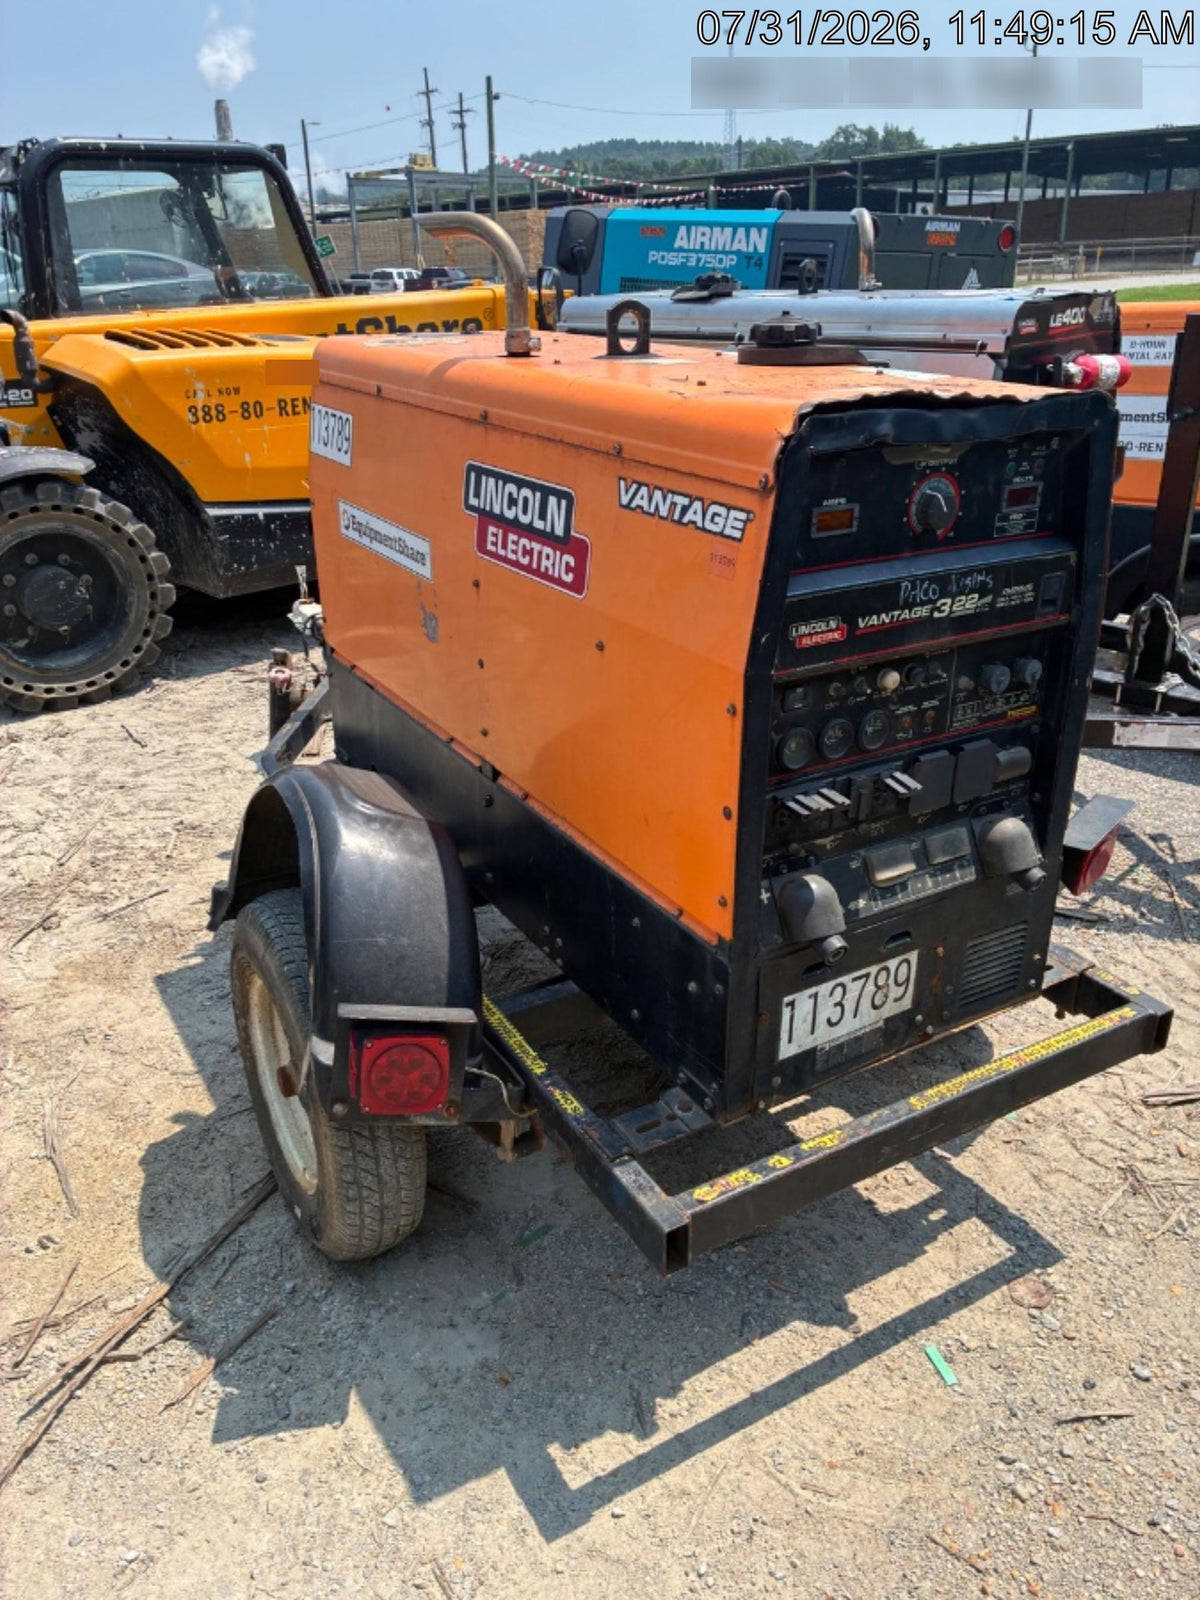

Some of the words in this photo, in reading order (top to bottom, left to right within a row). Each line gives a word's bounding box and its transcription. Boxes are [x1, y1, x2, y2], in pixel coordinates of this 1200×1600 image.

[674, 225, 768, 253] AIRMAN
[925, 220, 960, 232] AIRMAN
[744, 256, 763, 270] T4
[1050, 306, 1087, 327] LE400
[1123, 351, 1151, 361] ENTAL
[1154, 351, 1174, 361] RAT
[217, 386, 241, 398] NOW
[312, 405, 351, 456] 113789
[1119, 411, 1168, 424] mentS
[468, 470, 567, 537] LINCOLN
[618, 477, 748, 541] VANTAGE
[351, 513, 427, 567] EquipmentShare
[486, 525, 576, 584] ELECTRIC
[858, 606, 931, 628] VANTAGE
[933, 593, 979, 618] 322
[792, 620, 838, 637] LINCOLN
[785, 957, 912, 1044] 113789
